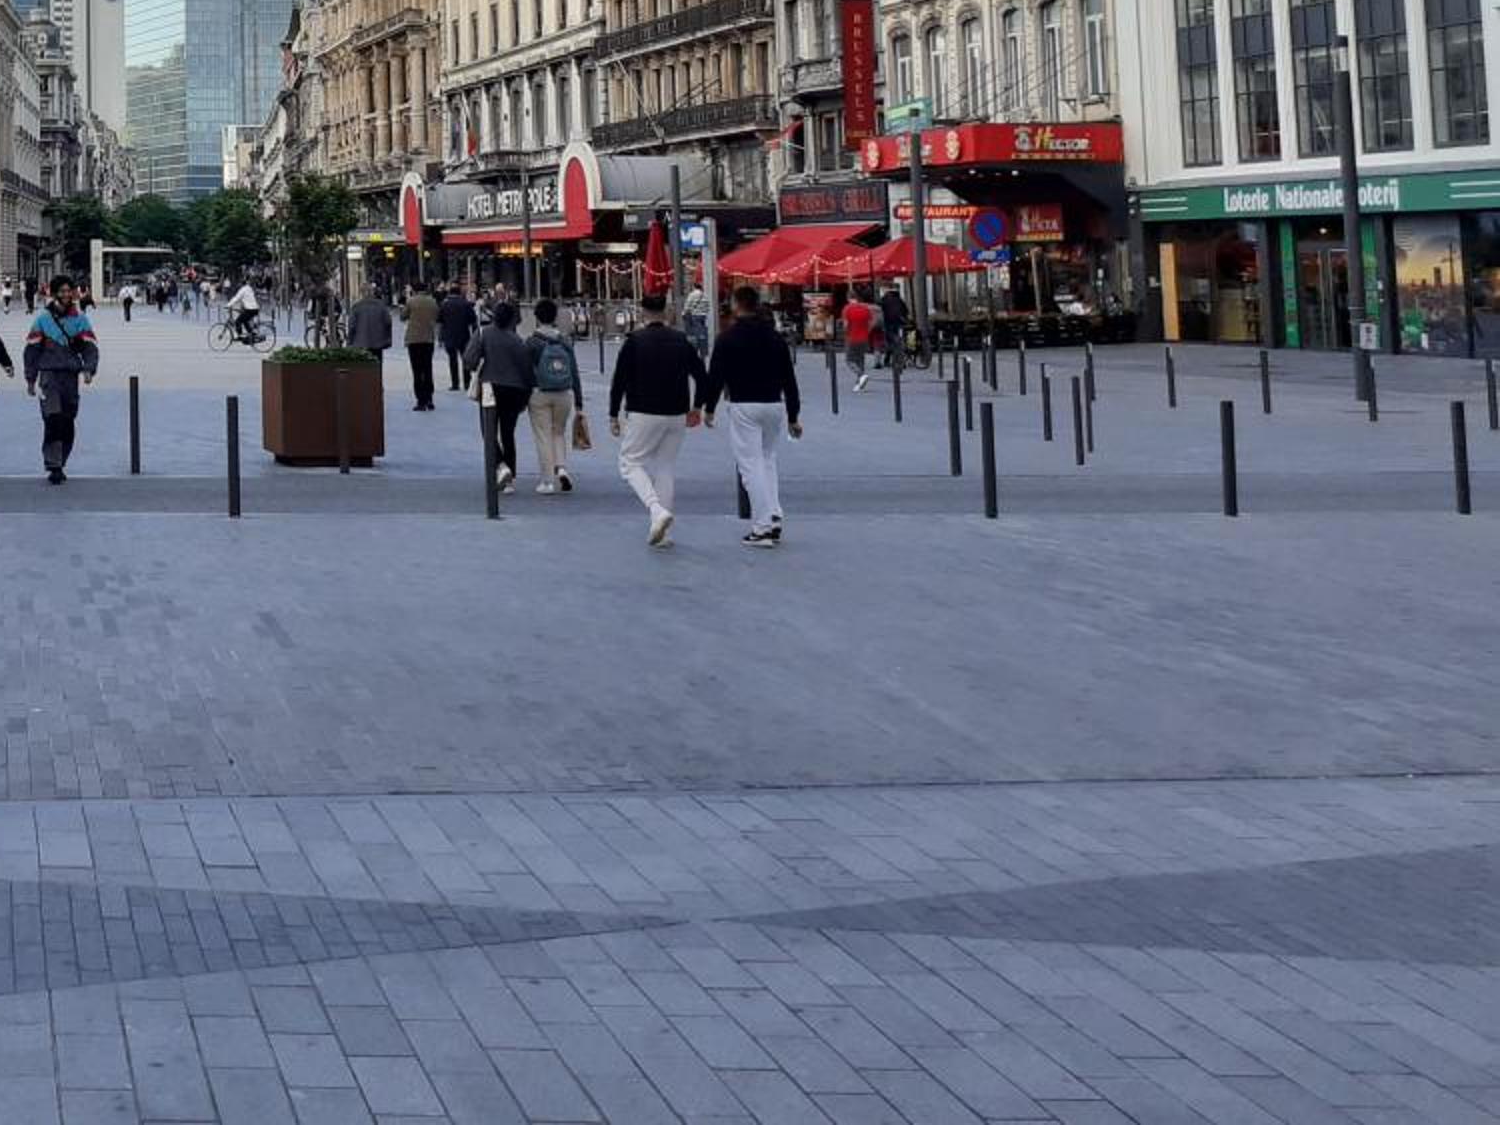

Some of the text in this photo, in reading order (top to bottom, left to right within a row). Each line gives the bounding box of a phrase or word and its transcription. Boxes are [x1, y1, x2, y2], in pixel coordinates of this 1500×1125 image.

[1223, 178, 1399, 212] Loterie Nationale oterij
